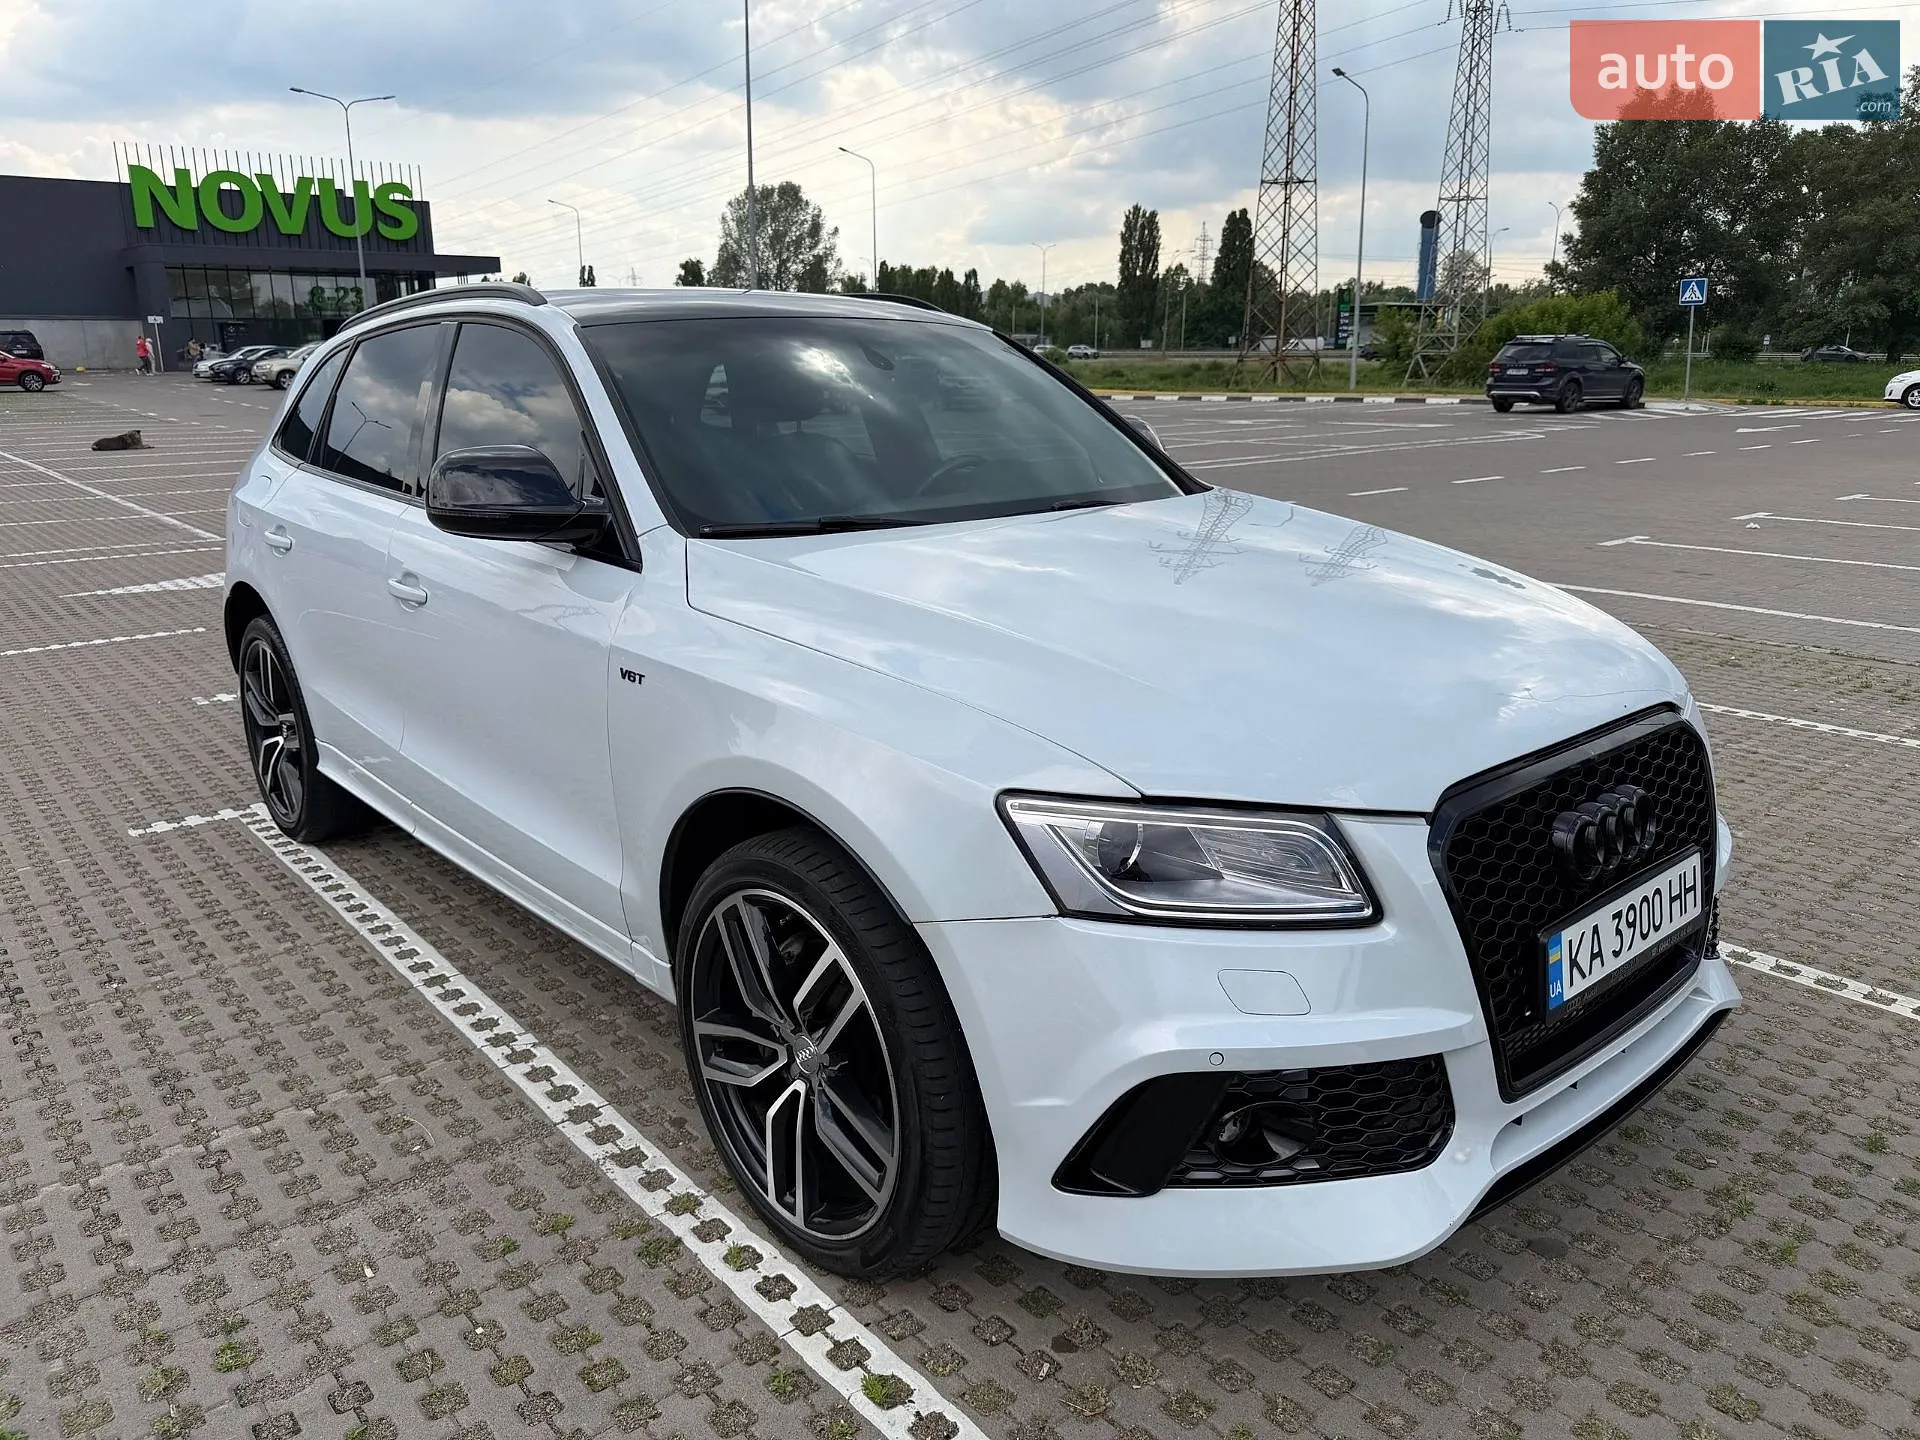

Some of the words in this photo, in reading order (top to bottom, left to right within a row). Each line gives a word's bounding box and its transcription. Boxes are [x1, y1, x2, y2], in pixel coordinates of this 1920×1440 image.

[128, 164, 419, 241] NOVUS
[619, 667, 646, 685] V6T
[1568, 923, 1605, 988] KA
[1611, 887, 1664, 959] 3900
[1668, 864, 1697, 924] HH
[1549, 982, 1562, 998] UA
